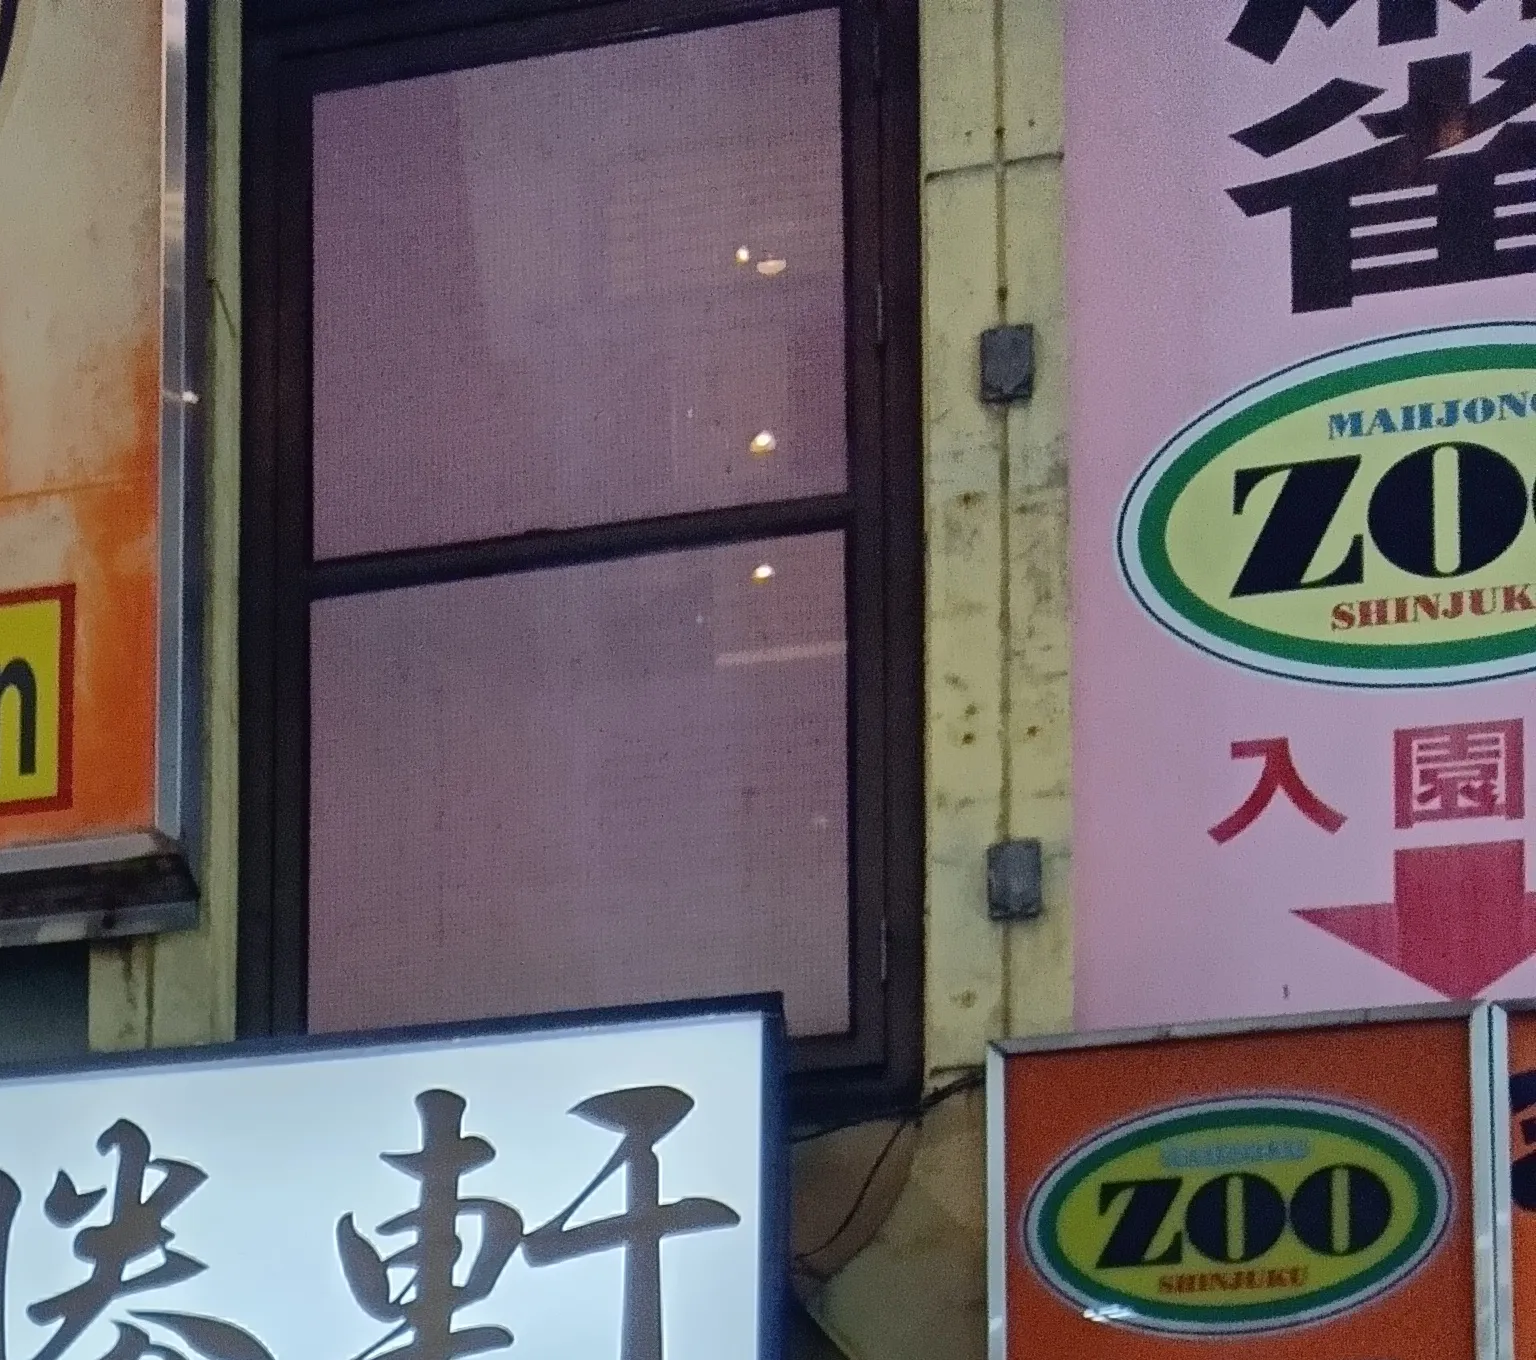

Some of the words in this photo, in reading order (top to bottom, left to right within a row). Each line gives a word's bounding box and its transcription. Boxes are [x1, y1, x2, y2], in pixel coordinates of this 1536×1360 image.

[1224, 0, 1536, 313] 雀
[1228, 440, 1536, 598] ZO
[1207, 718, 1524, 845] 入園
[1096, 1163, 1393, 1268] ZOO
[1159, 1265, 1308, 1294] SHINJUKU
